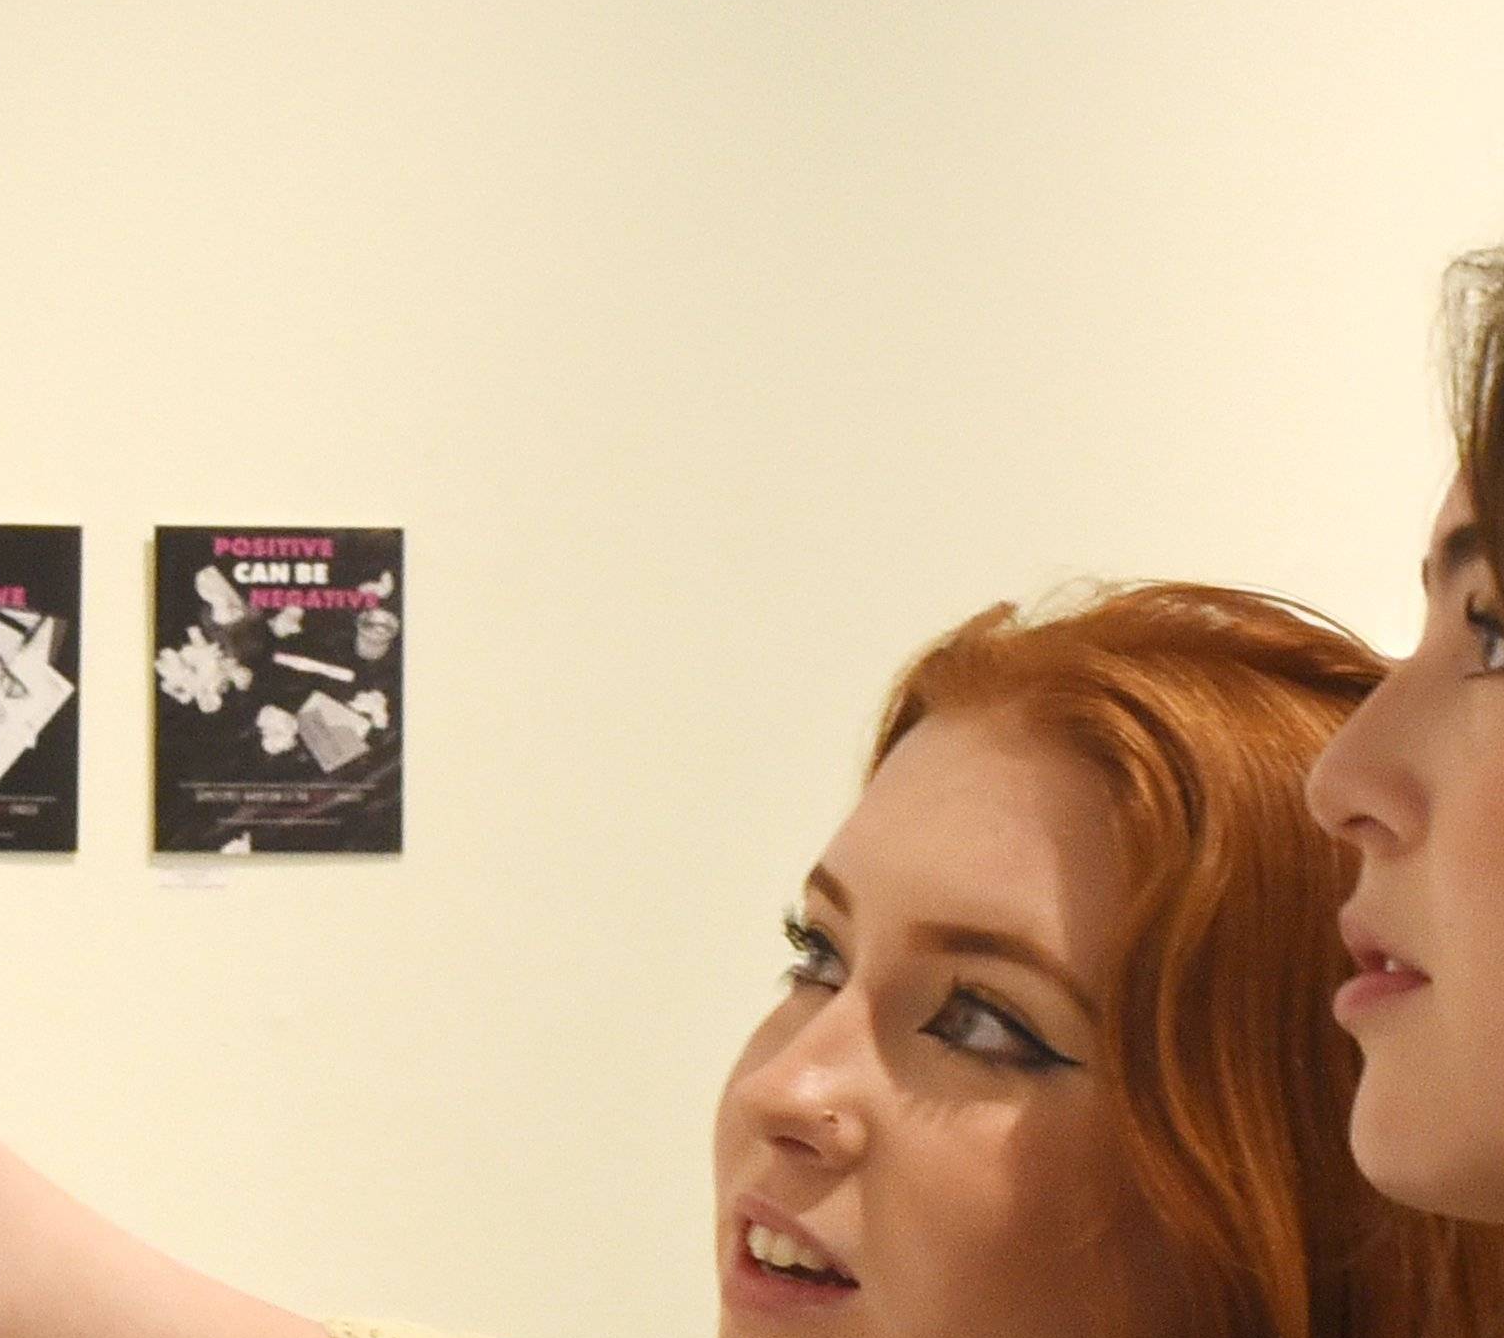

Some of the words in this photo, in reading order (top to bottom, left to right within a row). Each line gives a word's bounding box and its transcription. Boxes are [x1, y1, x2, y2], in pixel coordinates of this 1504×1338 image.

[213, 537, 333, 557] POSITIVE
[233, 562, 290, 584] CAN
[295, 562, 329, 584] BE
[250, 588, 379, 609] NEGATIVE
